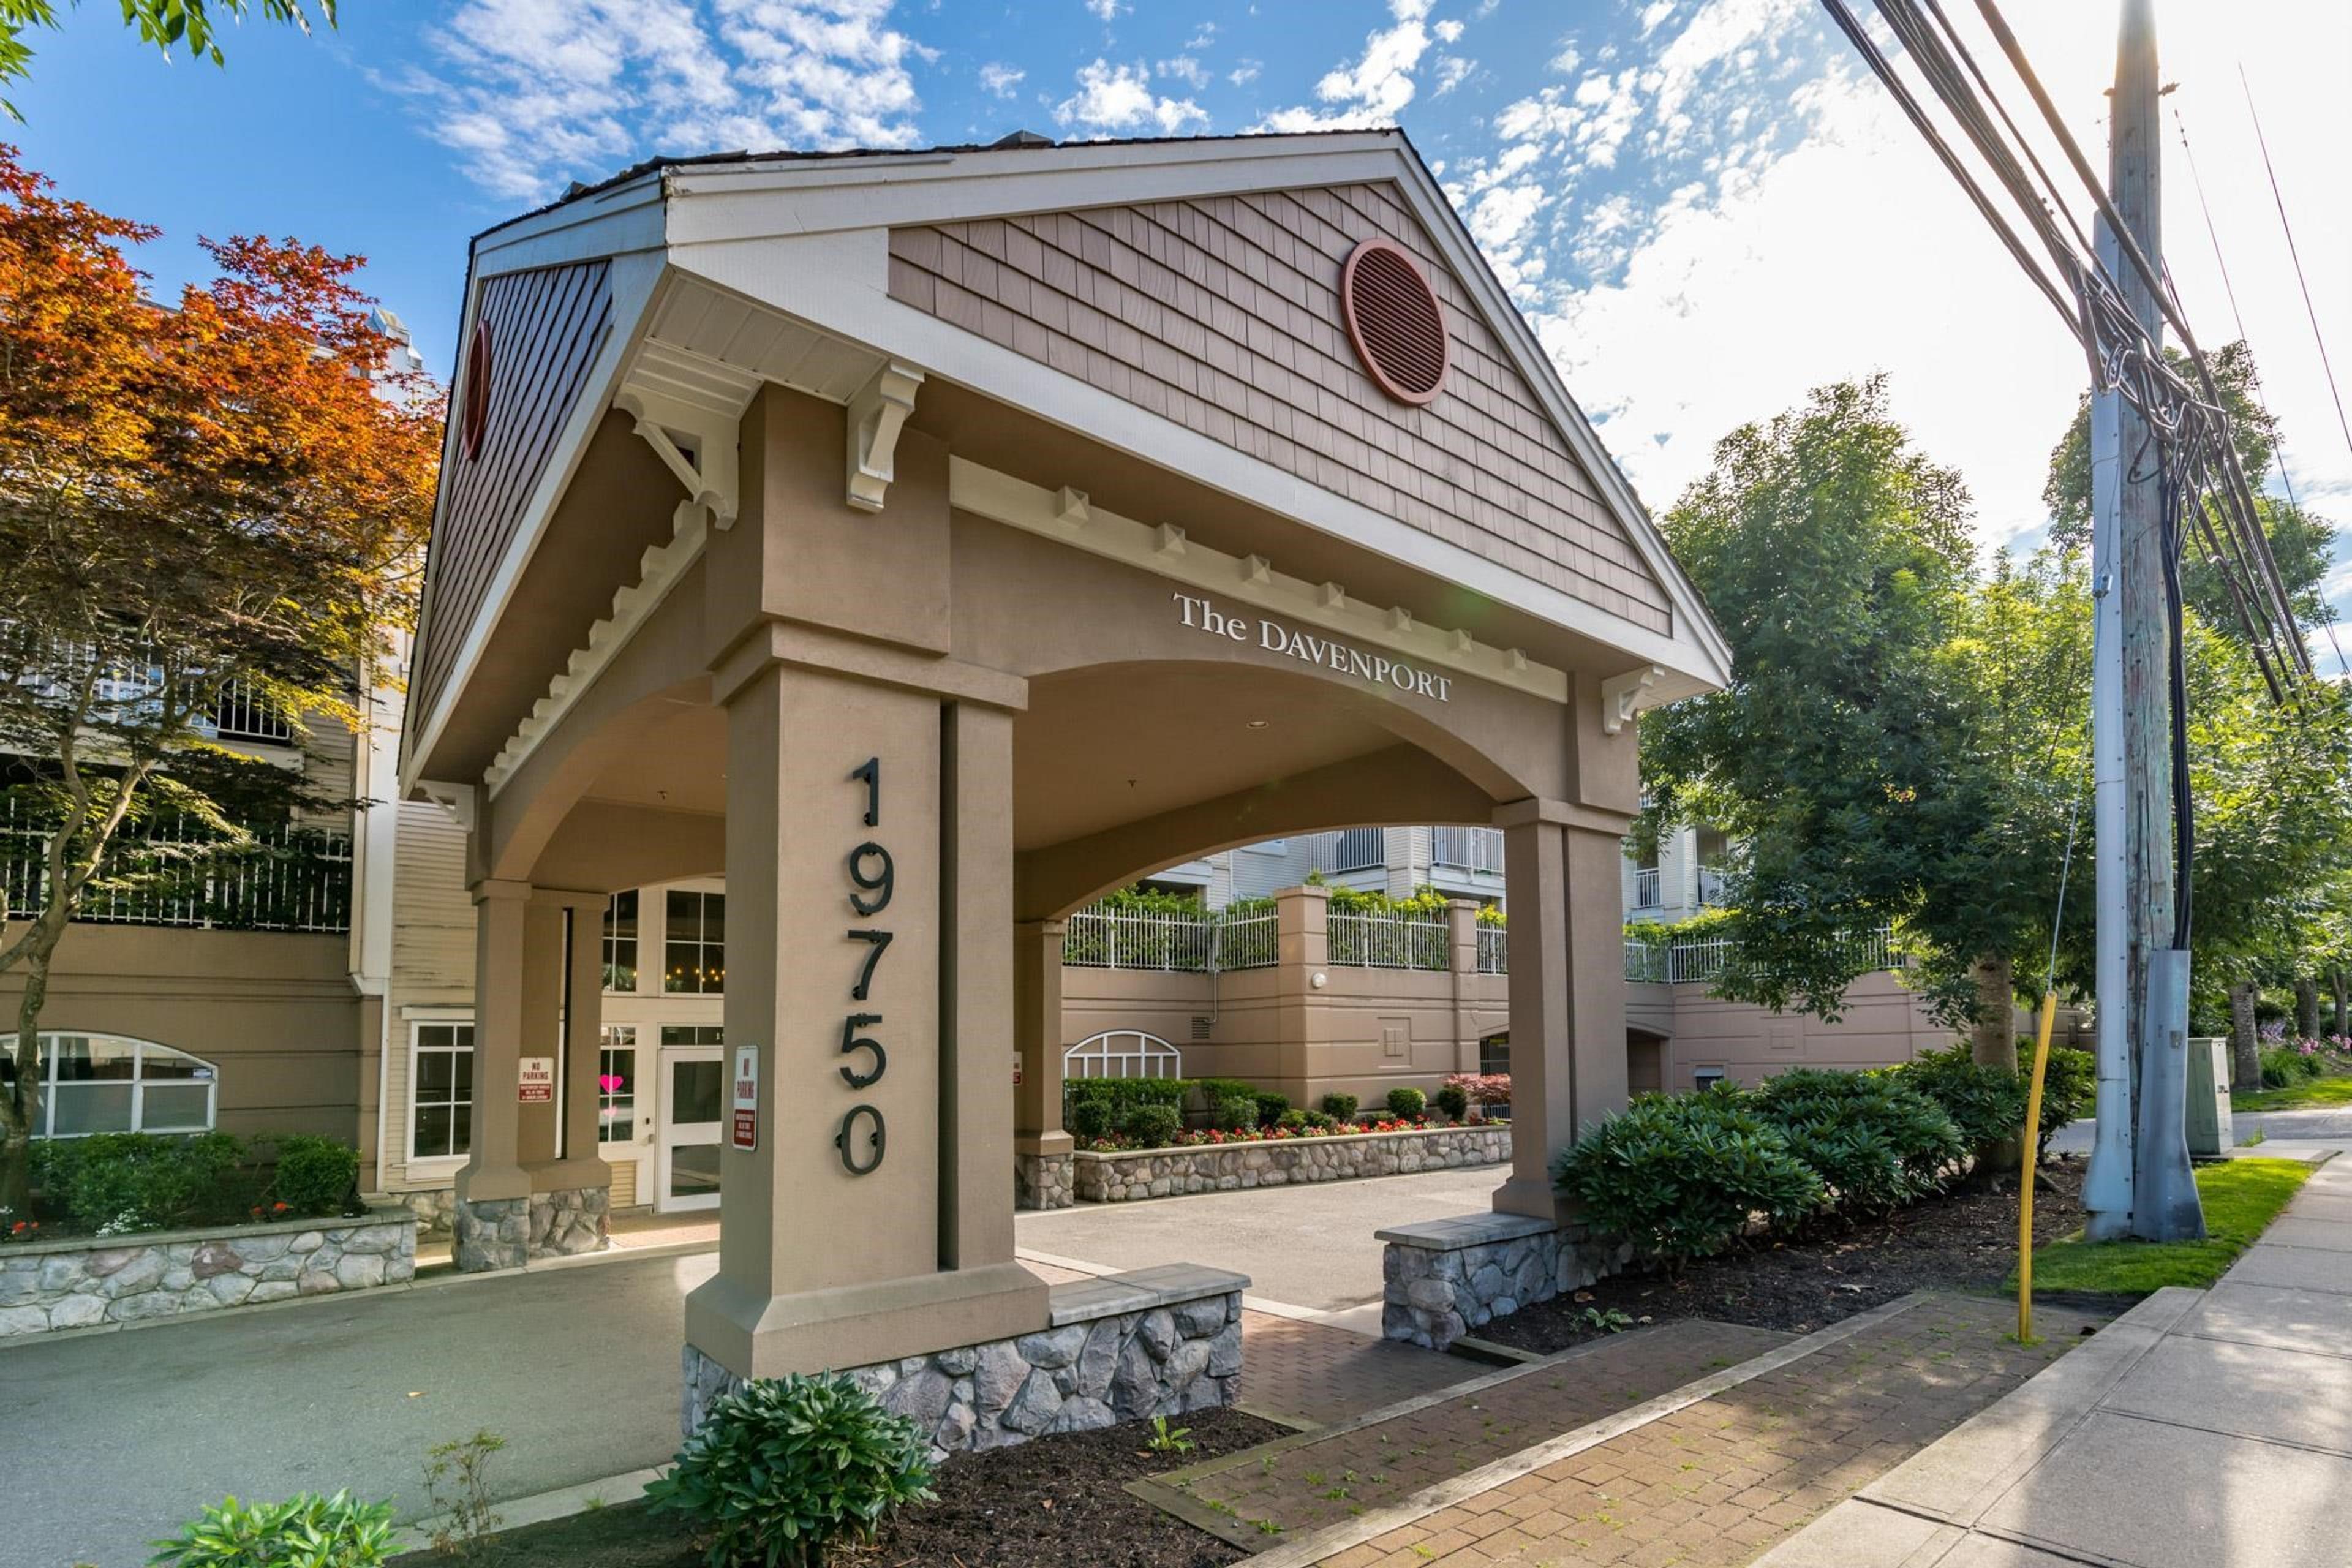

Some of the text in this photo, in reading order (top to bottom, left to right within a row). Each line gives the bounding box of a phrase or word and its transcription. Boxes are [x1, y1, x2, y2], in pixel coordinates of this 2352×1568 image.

[1173, 591, 1452, 703] The DAVENPORT
[840, 757, 895, 1175] 19750
[532, 1062, 540, 1071] NO
[737, 1080, 755, 1099] PARKING
